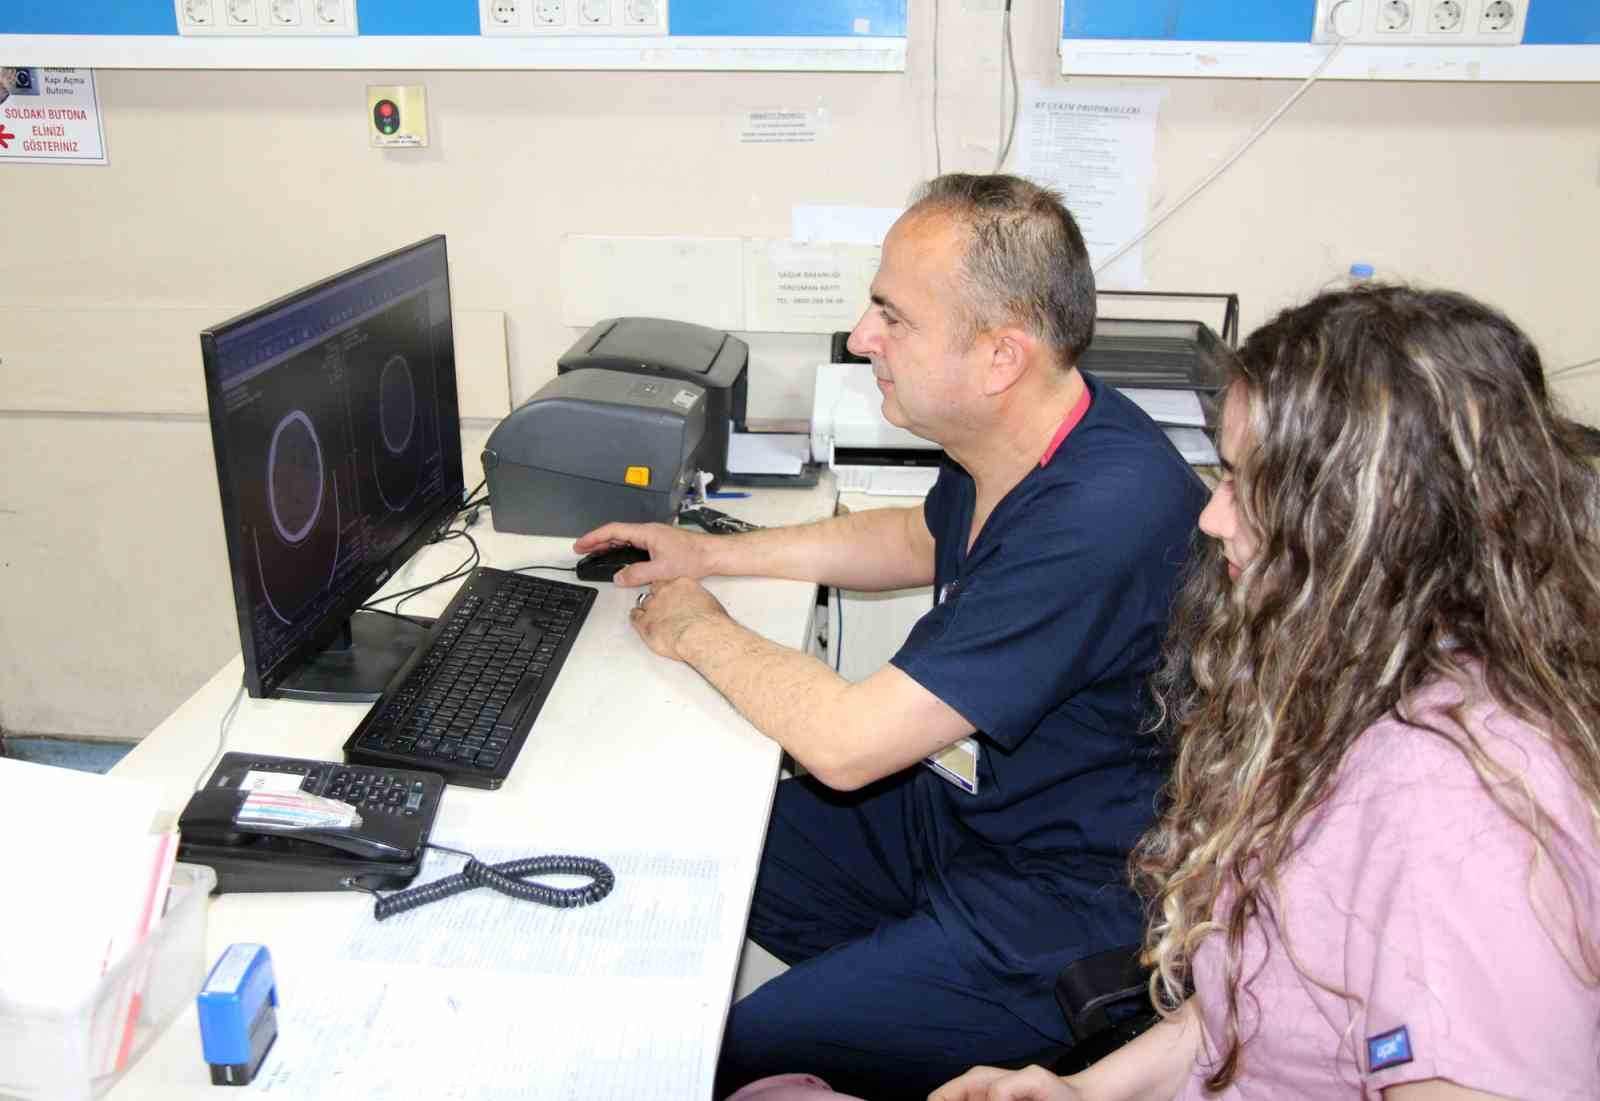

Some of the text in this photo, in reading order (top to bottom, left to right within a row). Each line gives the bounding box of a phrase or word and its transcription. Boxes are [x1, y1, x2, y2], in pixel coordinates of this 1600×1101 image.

[45, 75, 85, 85] Kapı Açma
[46, 86, 74, 95] Butonu
[5, 106, 87, 120] SOLDAKİ BUTONA
[32, 123, 65, 136] ELİNİZİ
[23, 138, 79, 152] GÖSTERİNİZ
